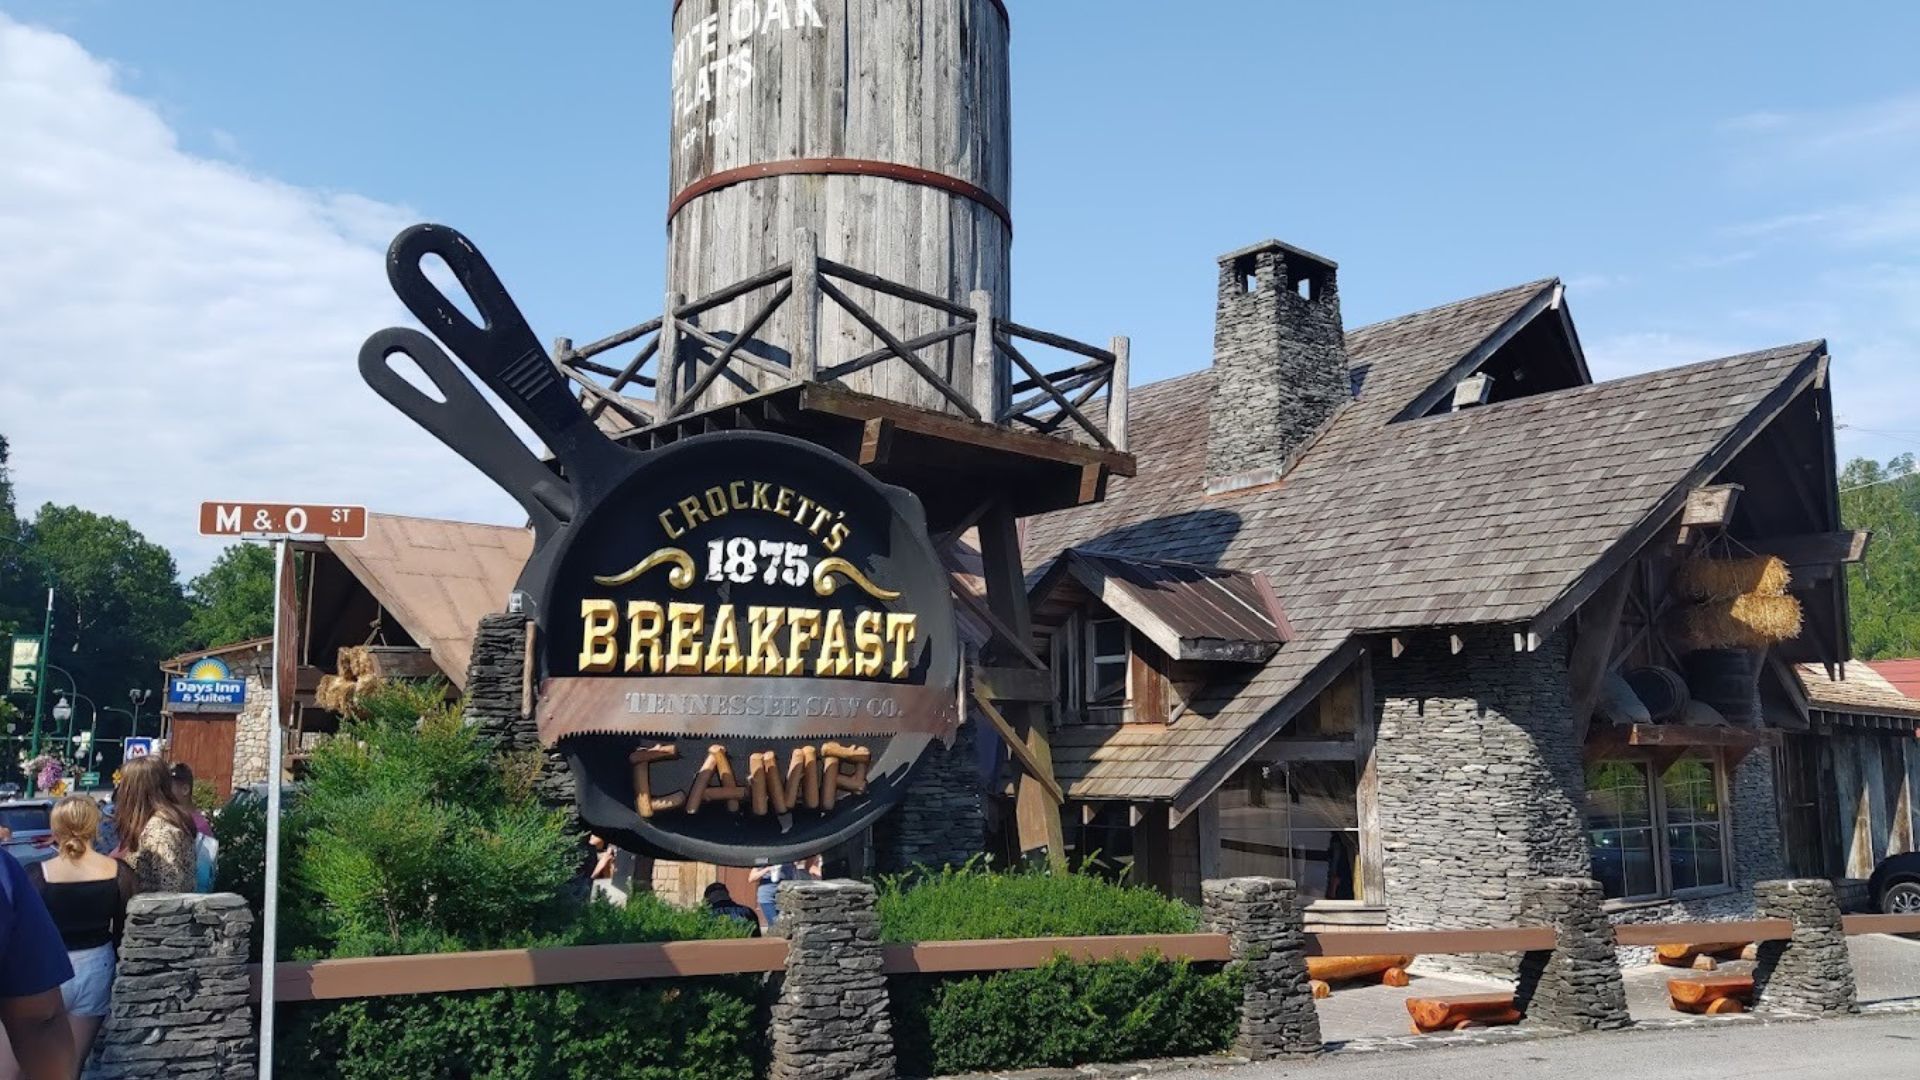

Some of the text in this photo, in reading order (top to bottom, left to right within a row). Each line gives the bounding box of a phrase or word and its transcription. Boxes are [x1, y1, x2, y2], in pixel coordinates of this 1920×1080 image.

[730, 0, 823, 40] OAK
[216, 505, 351, 534] M & O ST
[658, 480, 850, 552] CROCKETT'S
[705, 537, 810, 587] 1875
[578, 598, 917, 680] BREAKFAST
[175, 682, 241, 694] Days Inn
[182, 694, 232, 703] & Suites
[625, 692, 799, 718] TENNESSEE
[804, 695, 861, 718] SAW
[630, 742, 871, 819] CAMP
